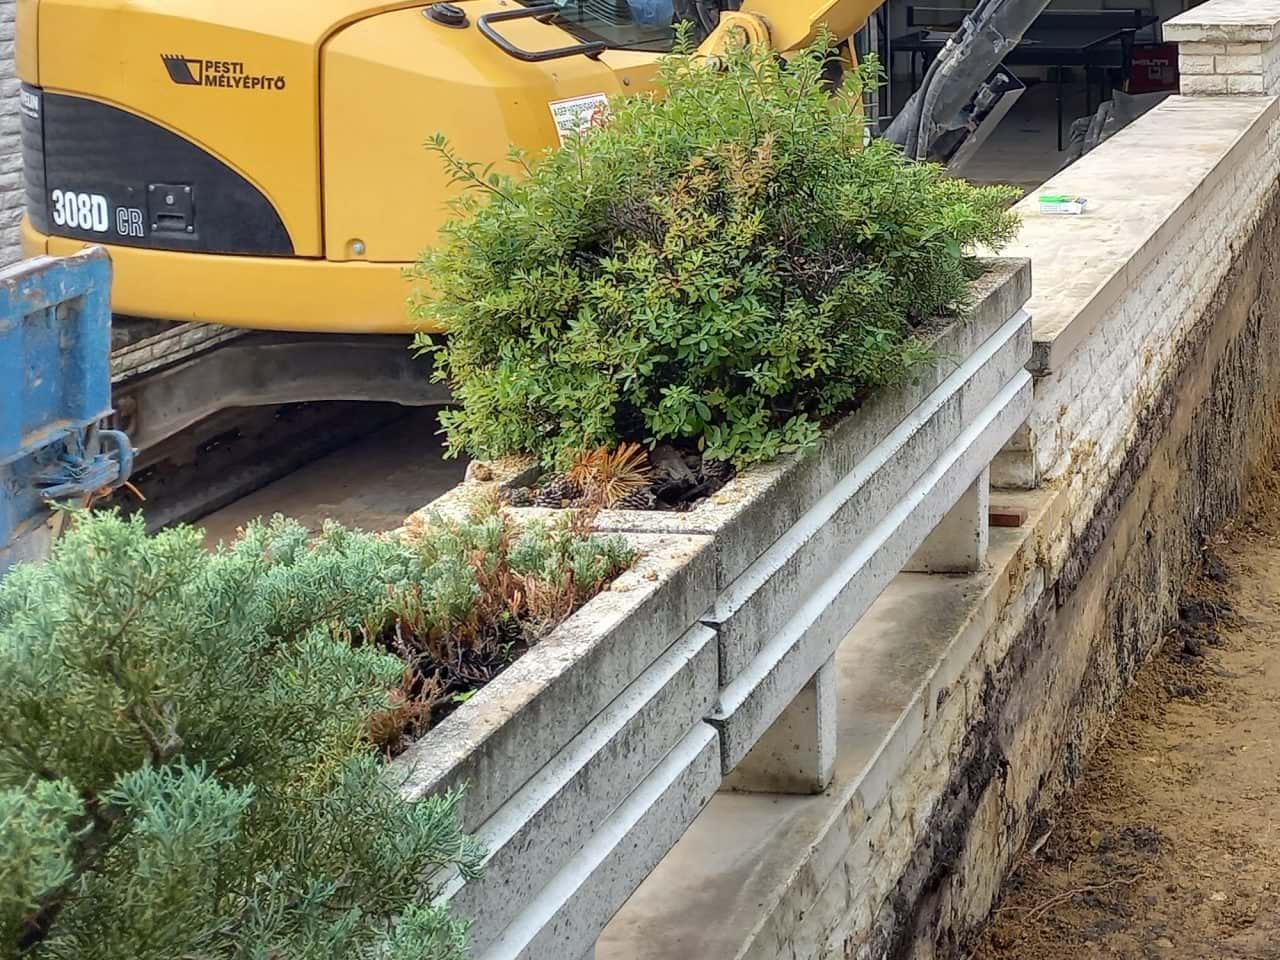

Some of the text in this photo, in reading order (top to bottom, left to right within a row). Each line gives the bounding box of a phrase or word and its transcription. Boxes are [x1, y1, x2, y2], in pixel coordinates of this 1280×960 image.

[204, 60, 244, 74] PESTI
[52, 189, 144, 237] 308D CR
